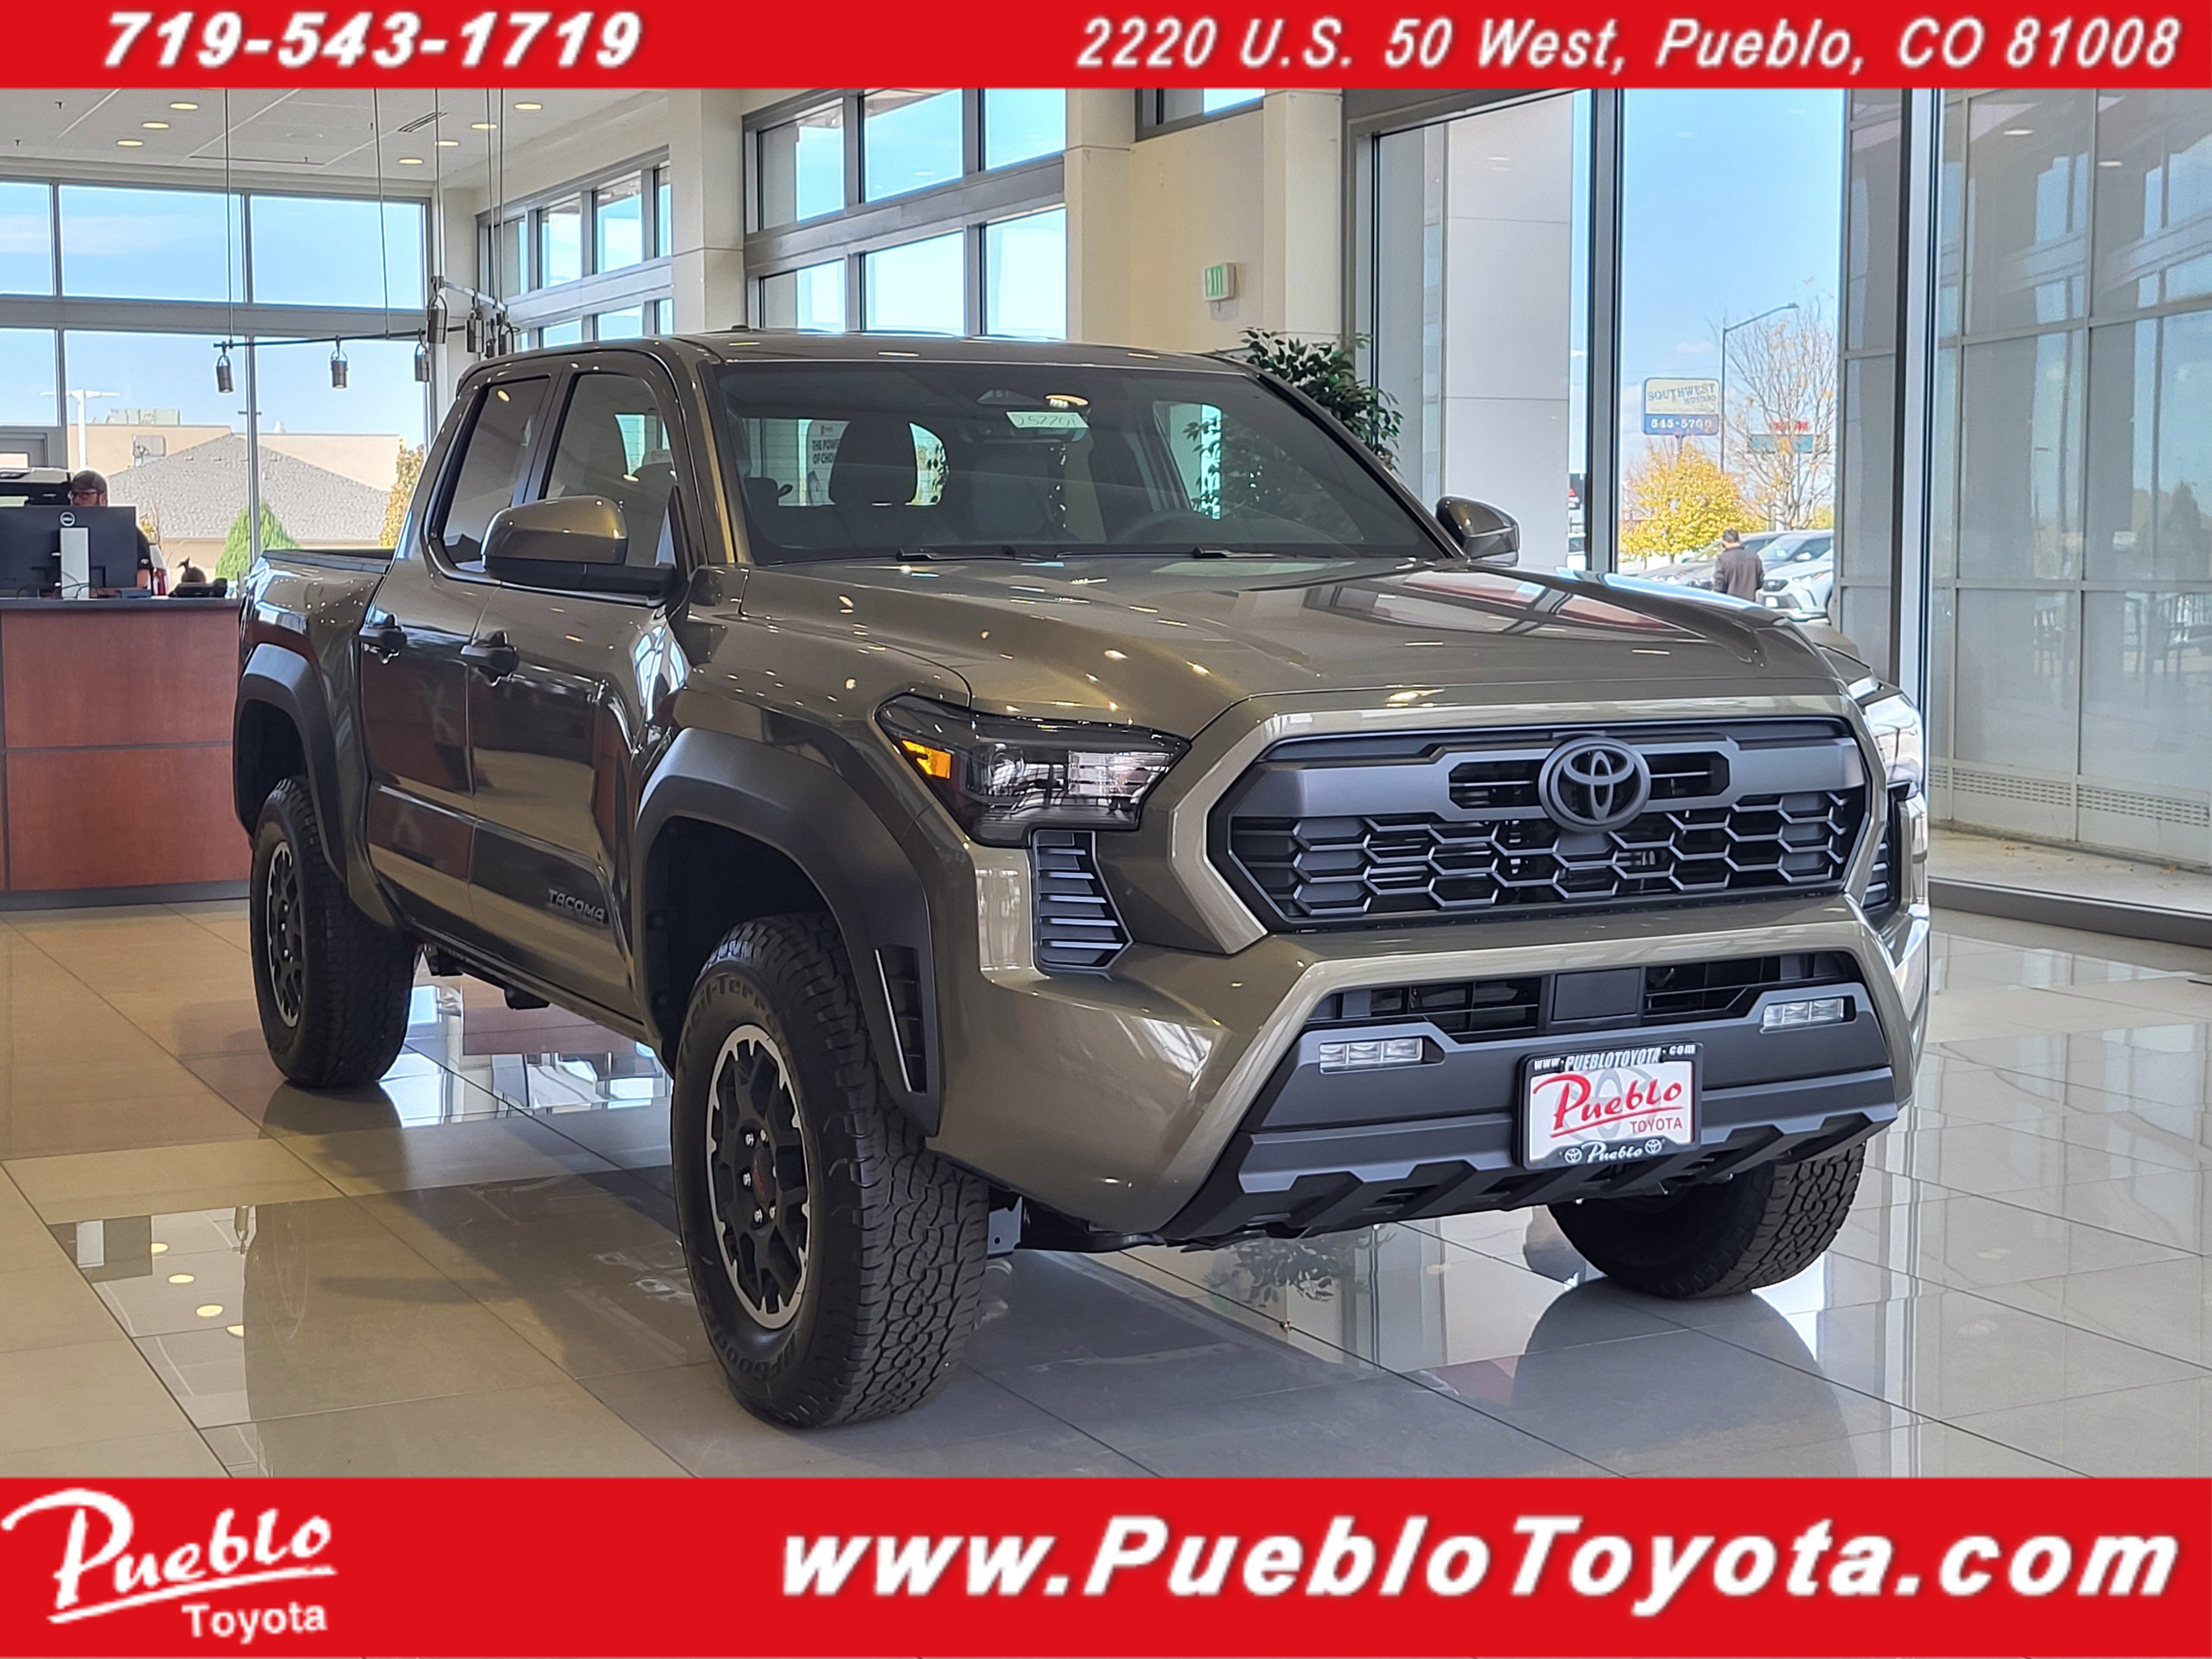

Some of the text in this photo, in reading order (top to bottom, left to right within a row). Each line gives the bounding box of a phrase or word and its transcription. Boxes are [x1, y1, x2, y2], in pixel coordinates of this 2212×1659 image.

[1647, 383, 1715, 401] SOUTHWEST
[548, 888, 606, 923] TACOMA
[1532, 1073, 1682, 1130] Pueblo
[1630, 1117, 1683, 1134] TOYOTA
[1581, 1140, 1643, 1164] Pueblo
